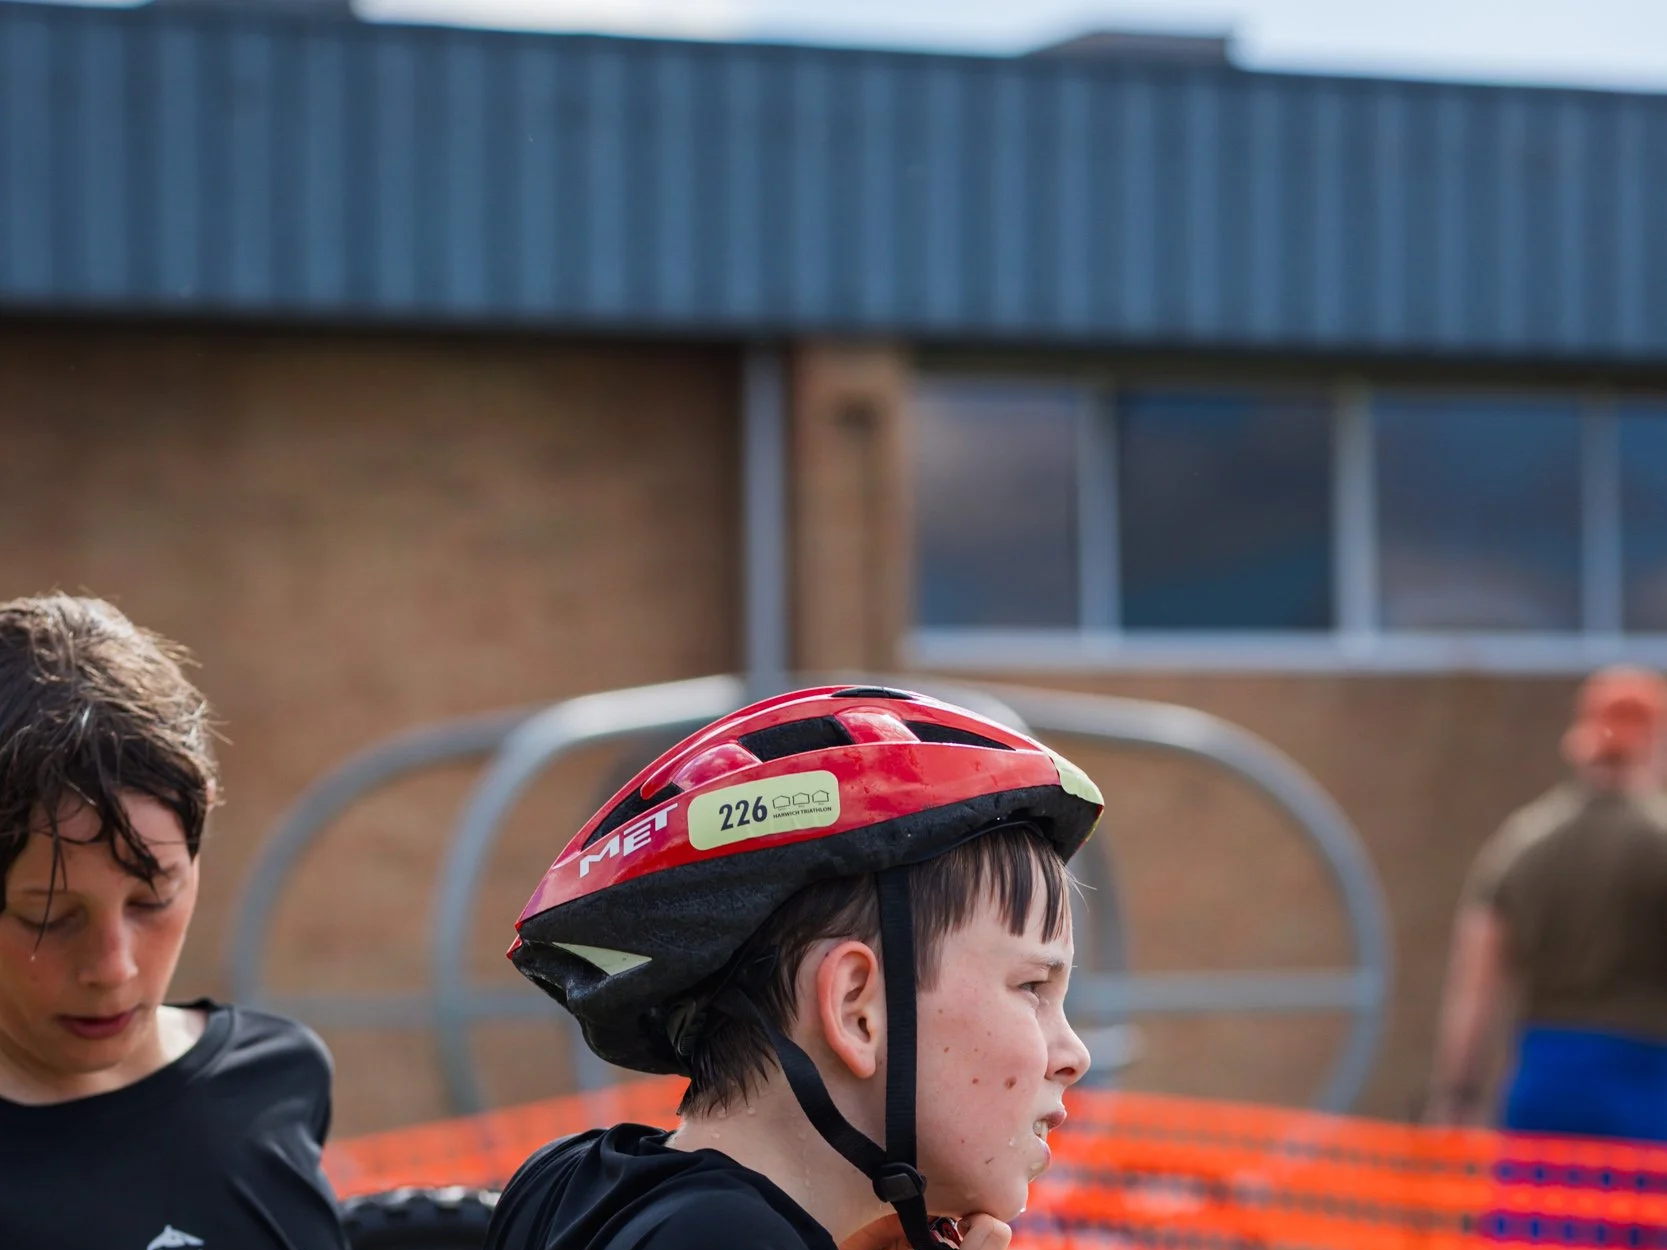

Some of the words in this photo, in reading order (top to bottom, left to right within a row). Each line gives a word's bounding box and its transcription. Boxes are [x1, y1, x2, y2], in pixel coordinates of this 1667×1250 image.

[718, 796, 768, 832] 226
[772, 810, 801, 819] HARWICH
[800, 806, 832, 815] TRIATHLON
[579, 802, 678, 878] MET
